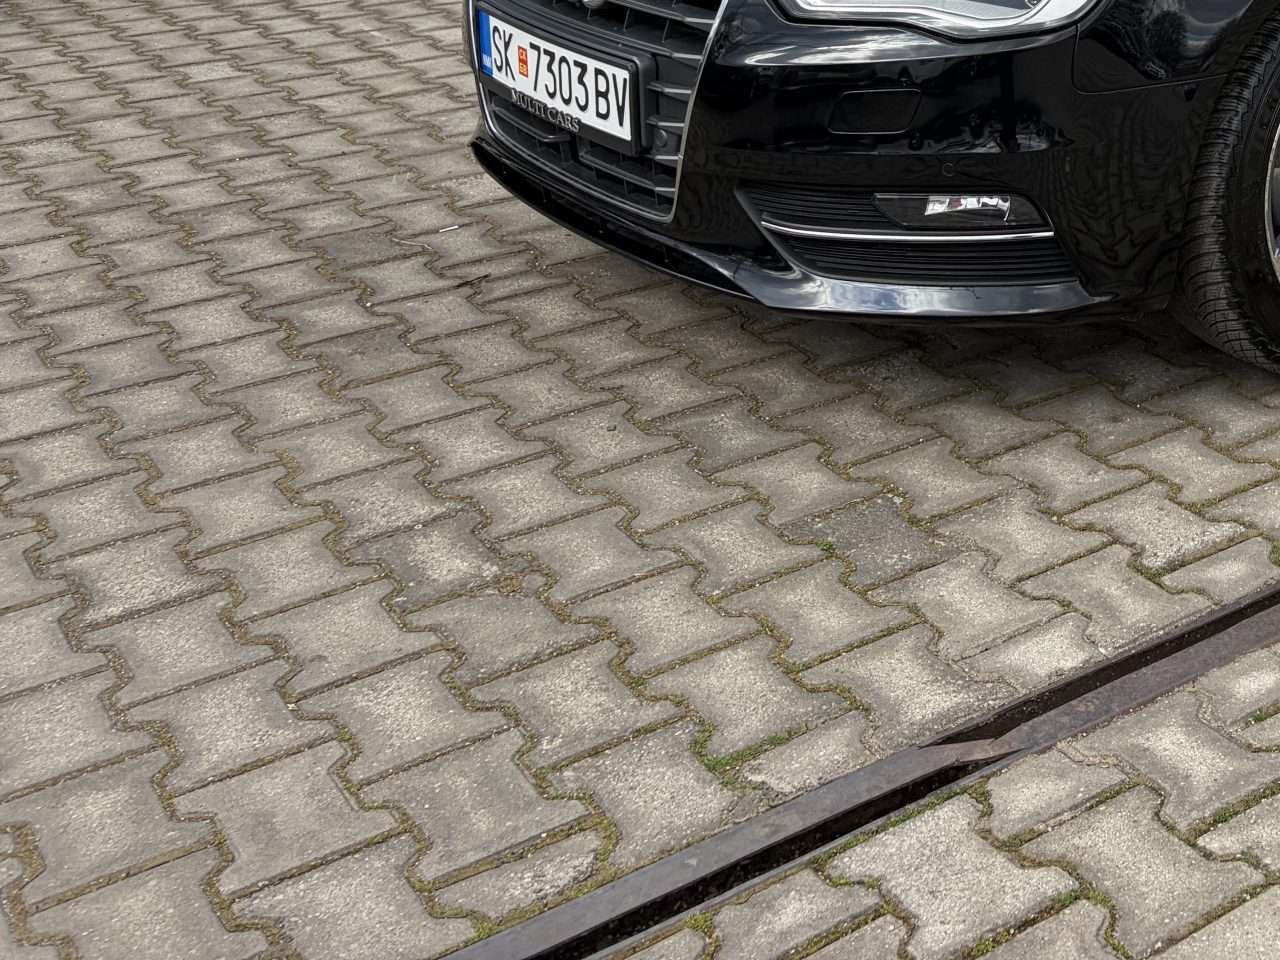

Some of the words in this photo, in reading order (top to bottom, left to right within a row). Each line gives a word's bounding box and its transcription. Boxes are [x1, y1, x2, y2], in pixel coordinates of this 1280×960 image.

[492, 25, 516, 81] SK
[529, 41, 590, 112] 7303
[594, 67, 628, 128] BV
[511, 88, 547, 117] MULTI
[547, 106, 580, 133] CARS
